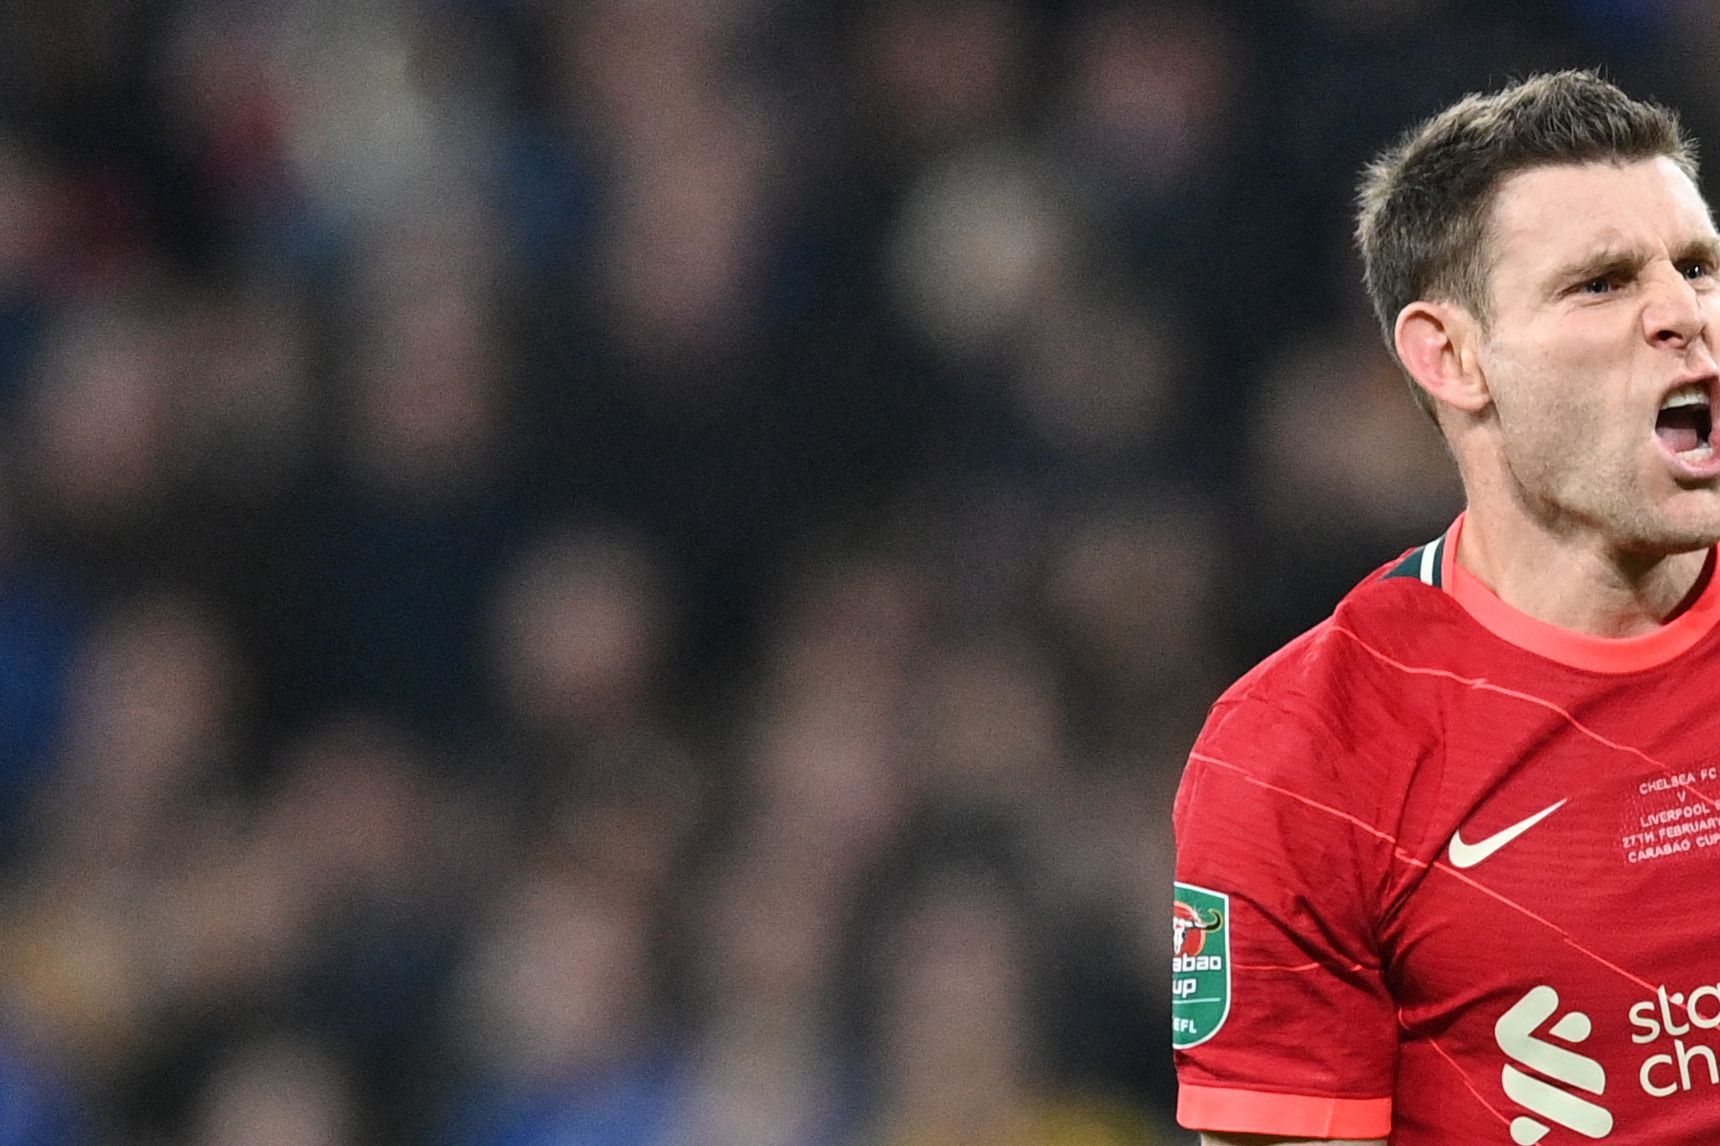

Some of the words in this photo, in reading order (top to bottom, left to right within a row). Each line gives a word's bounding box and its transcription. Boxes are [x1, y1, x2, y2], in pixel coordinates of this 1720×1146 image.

[1639, 772, 1696, 795] CHELSEA
[1700, 767, 1717, 780] FC
[1677, 789, 1687, 803] V
[1640, 802, 1711, 828] LIVERPOOL
[1622, 832, 1655, 849] 27TH
[1628, 839, 1691, 864] CARABAO
[1696, 832, 1720, 848] CUP
[1172, 1016, 1198, 1035] EFL
